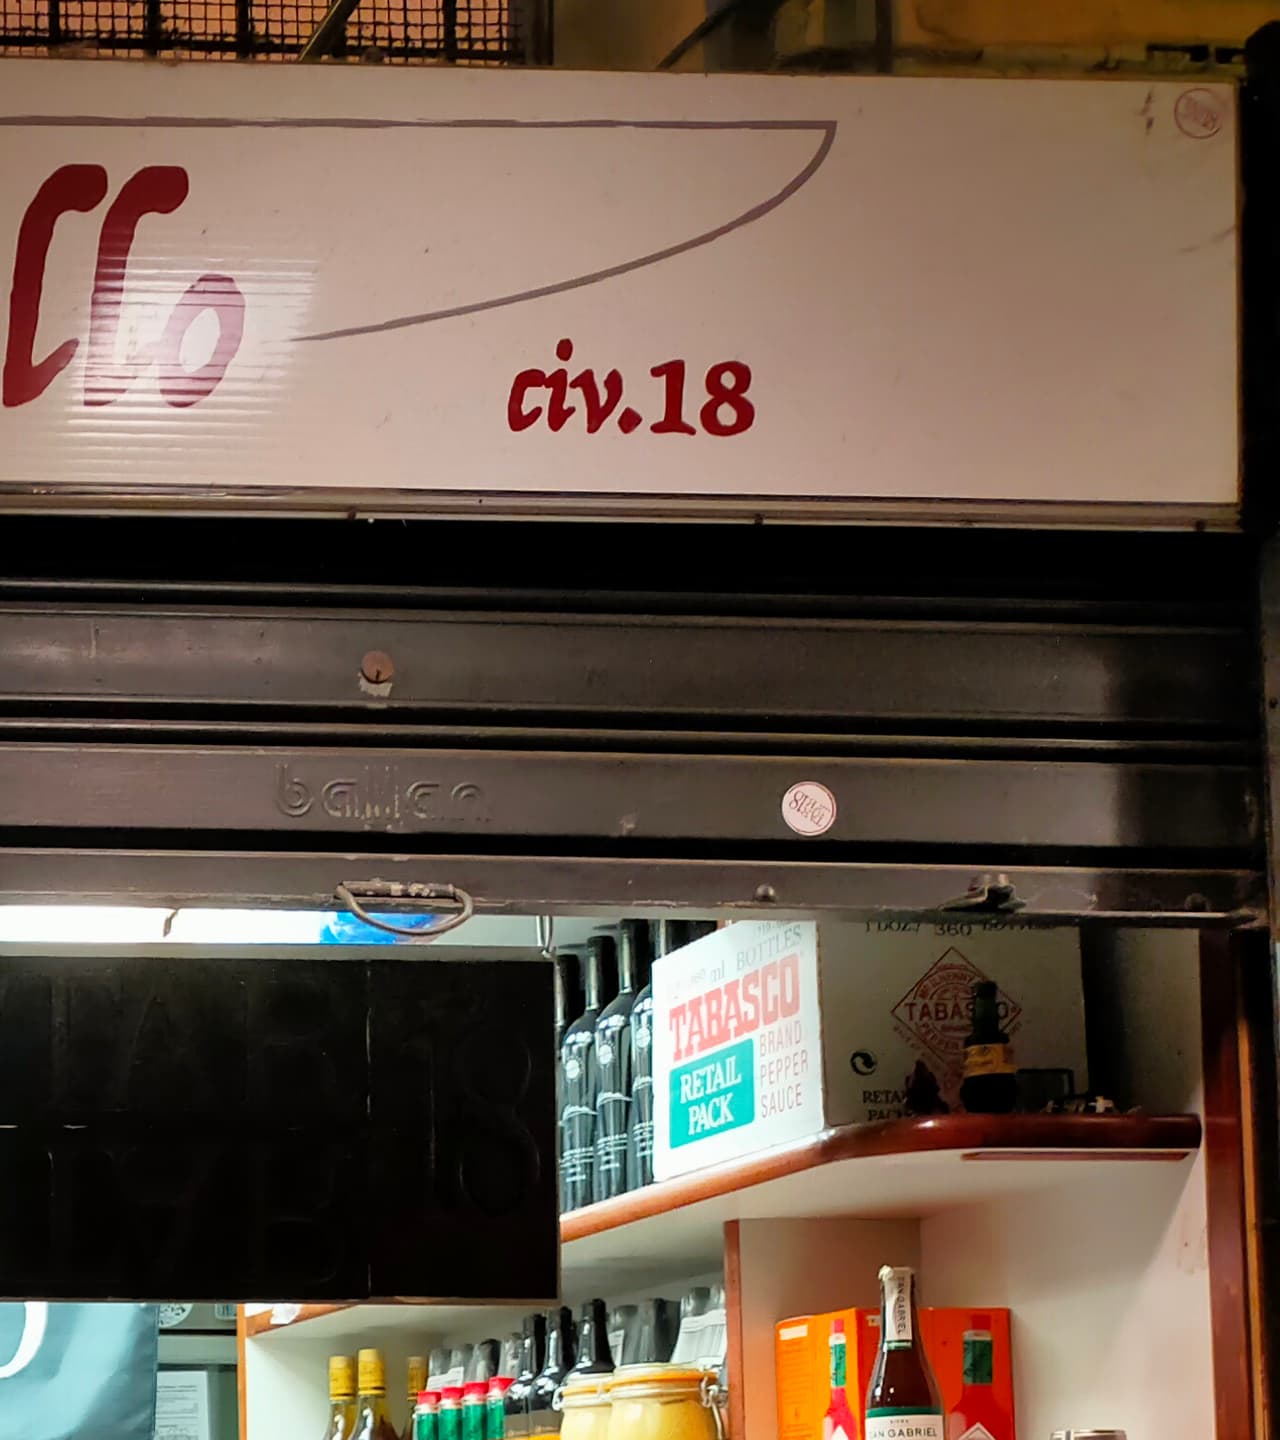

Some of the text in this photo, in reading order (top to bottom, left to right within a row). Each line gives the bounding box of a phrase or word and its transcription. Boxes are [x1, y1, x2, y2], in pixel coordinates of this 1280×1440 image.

[507, 338, 756, 437] civ.18
[737, 924, 803, 972] BOTTLES
[669, 952, 801, 1062] TABASCO
[904, 1001, 1009, 1021] TABASO
[759, 1020, 802, 1058] BRAND
[679, 1055, 742, 1105] RETAIL
[759, 1049, 809, 1087] PEPPER
[687, 1092, 735, 1136] PACK
[760, 1083, 803, 1119] SAUCE
[887, 1427, 938, 1439] GABRIEL
